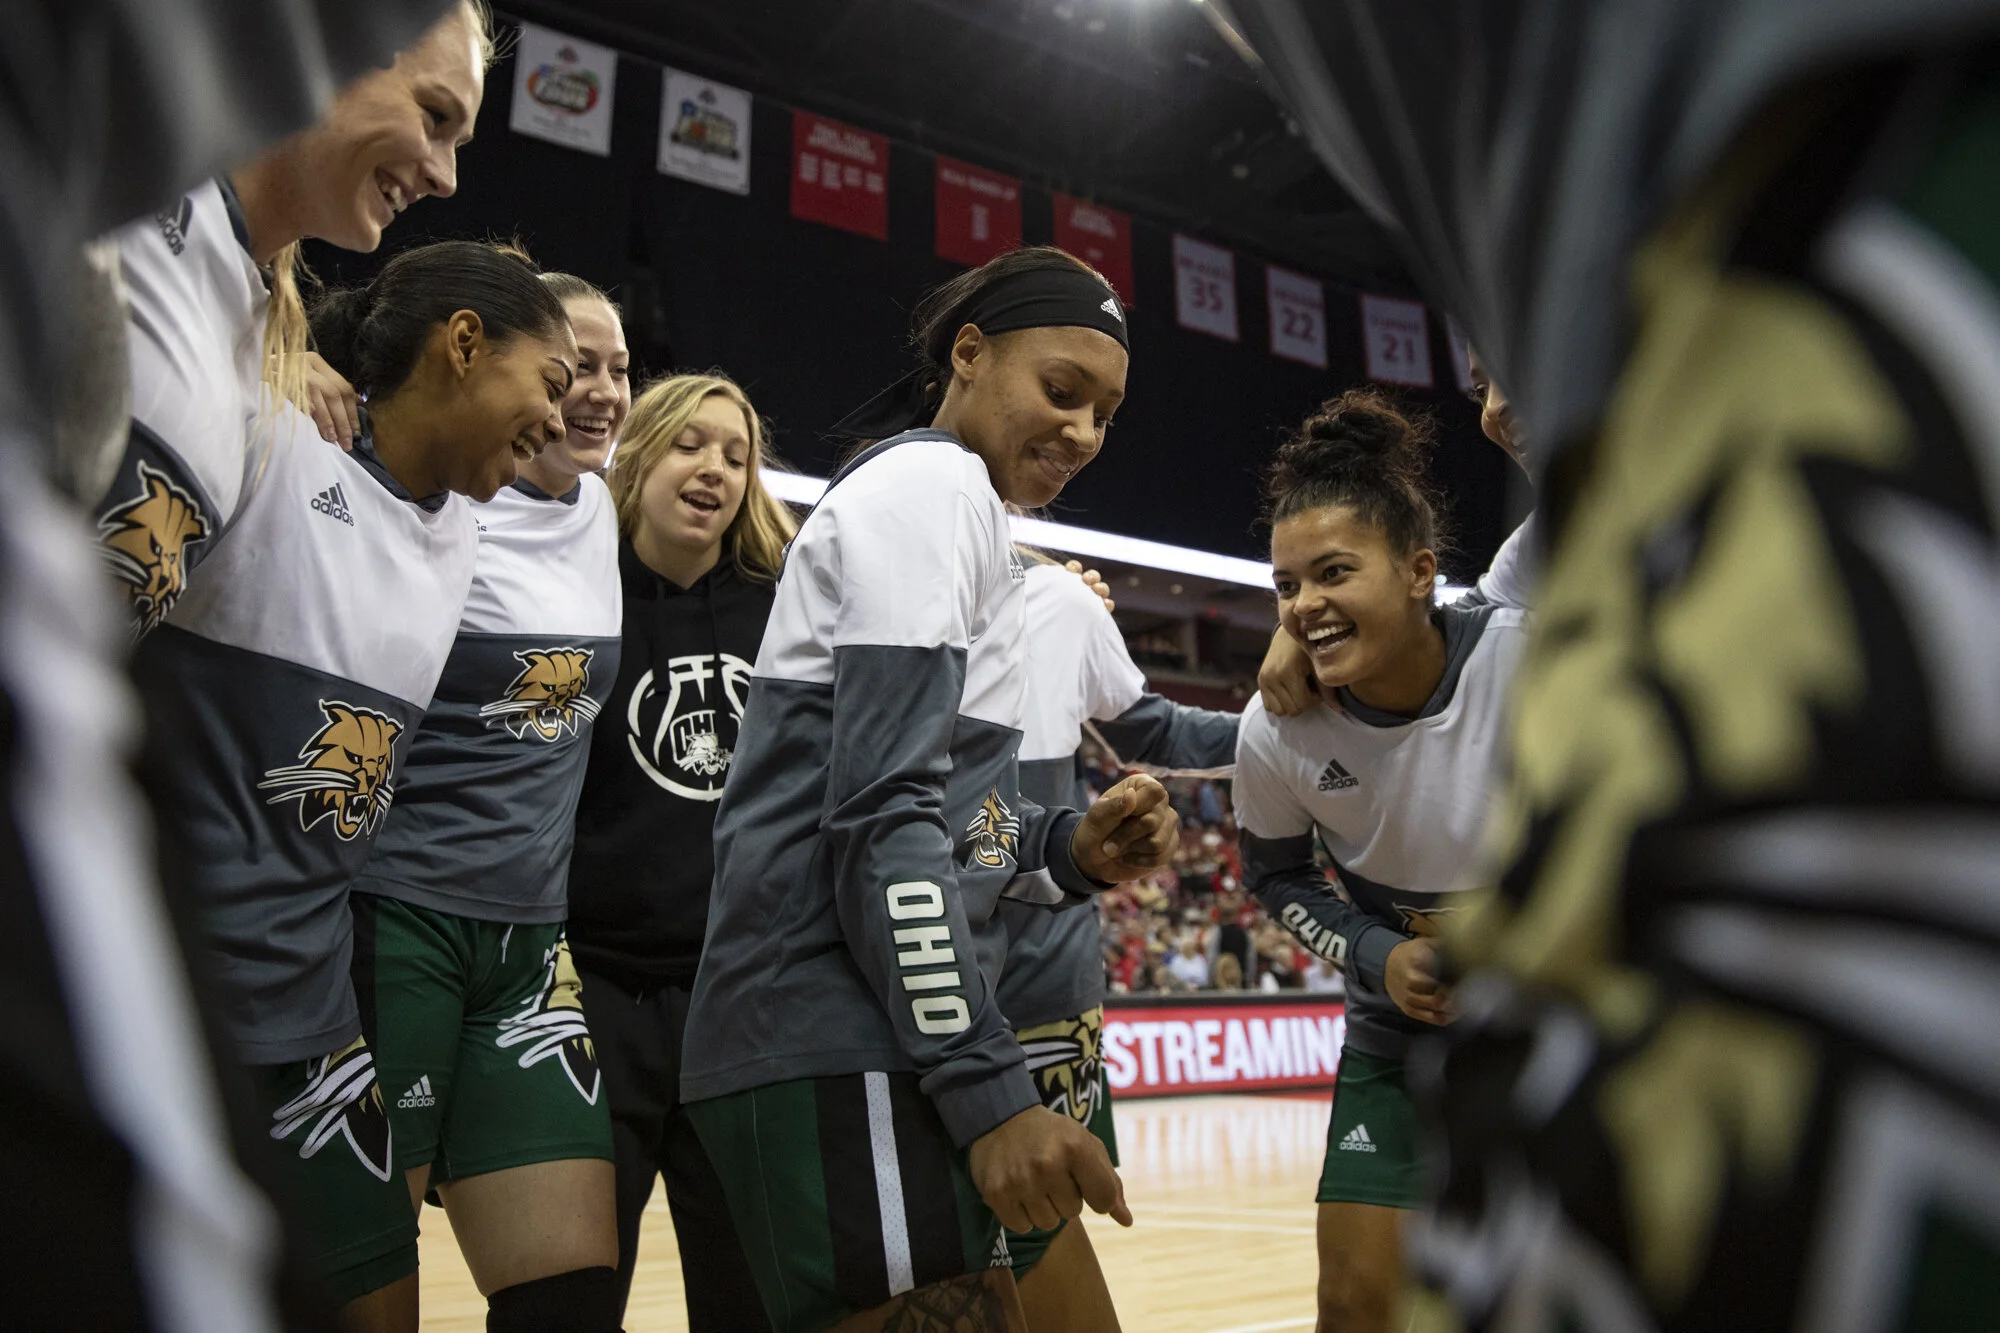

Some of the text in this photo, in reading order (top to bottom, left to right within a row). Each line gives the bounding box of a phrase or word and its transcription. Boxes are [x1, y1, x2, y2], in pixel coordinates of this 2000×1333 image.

[1190, 276, 1222, 313] 35
[1282, 306, 1315, 344] 22
[1382, 333, 1416, 366] 21
[311, 498, 354, 527] adidas
[1318, 775, 1359, 792] adidas
[1282, 902, 1347, 967] OHIO
[886, 881, 972, 1034] OHIO
[397, 1095, 436, 1108] adidas
[1339, 1140, 1377, 1153] adidas
